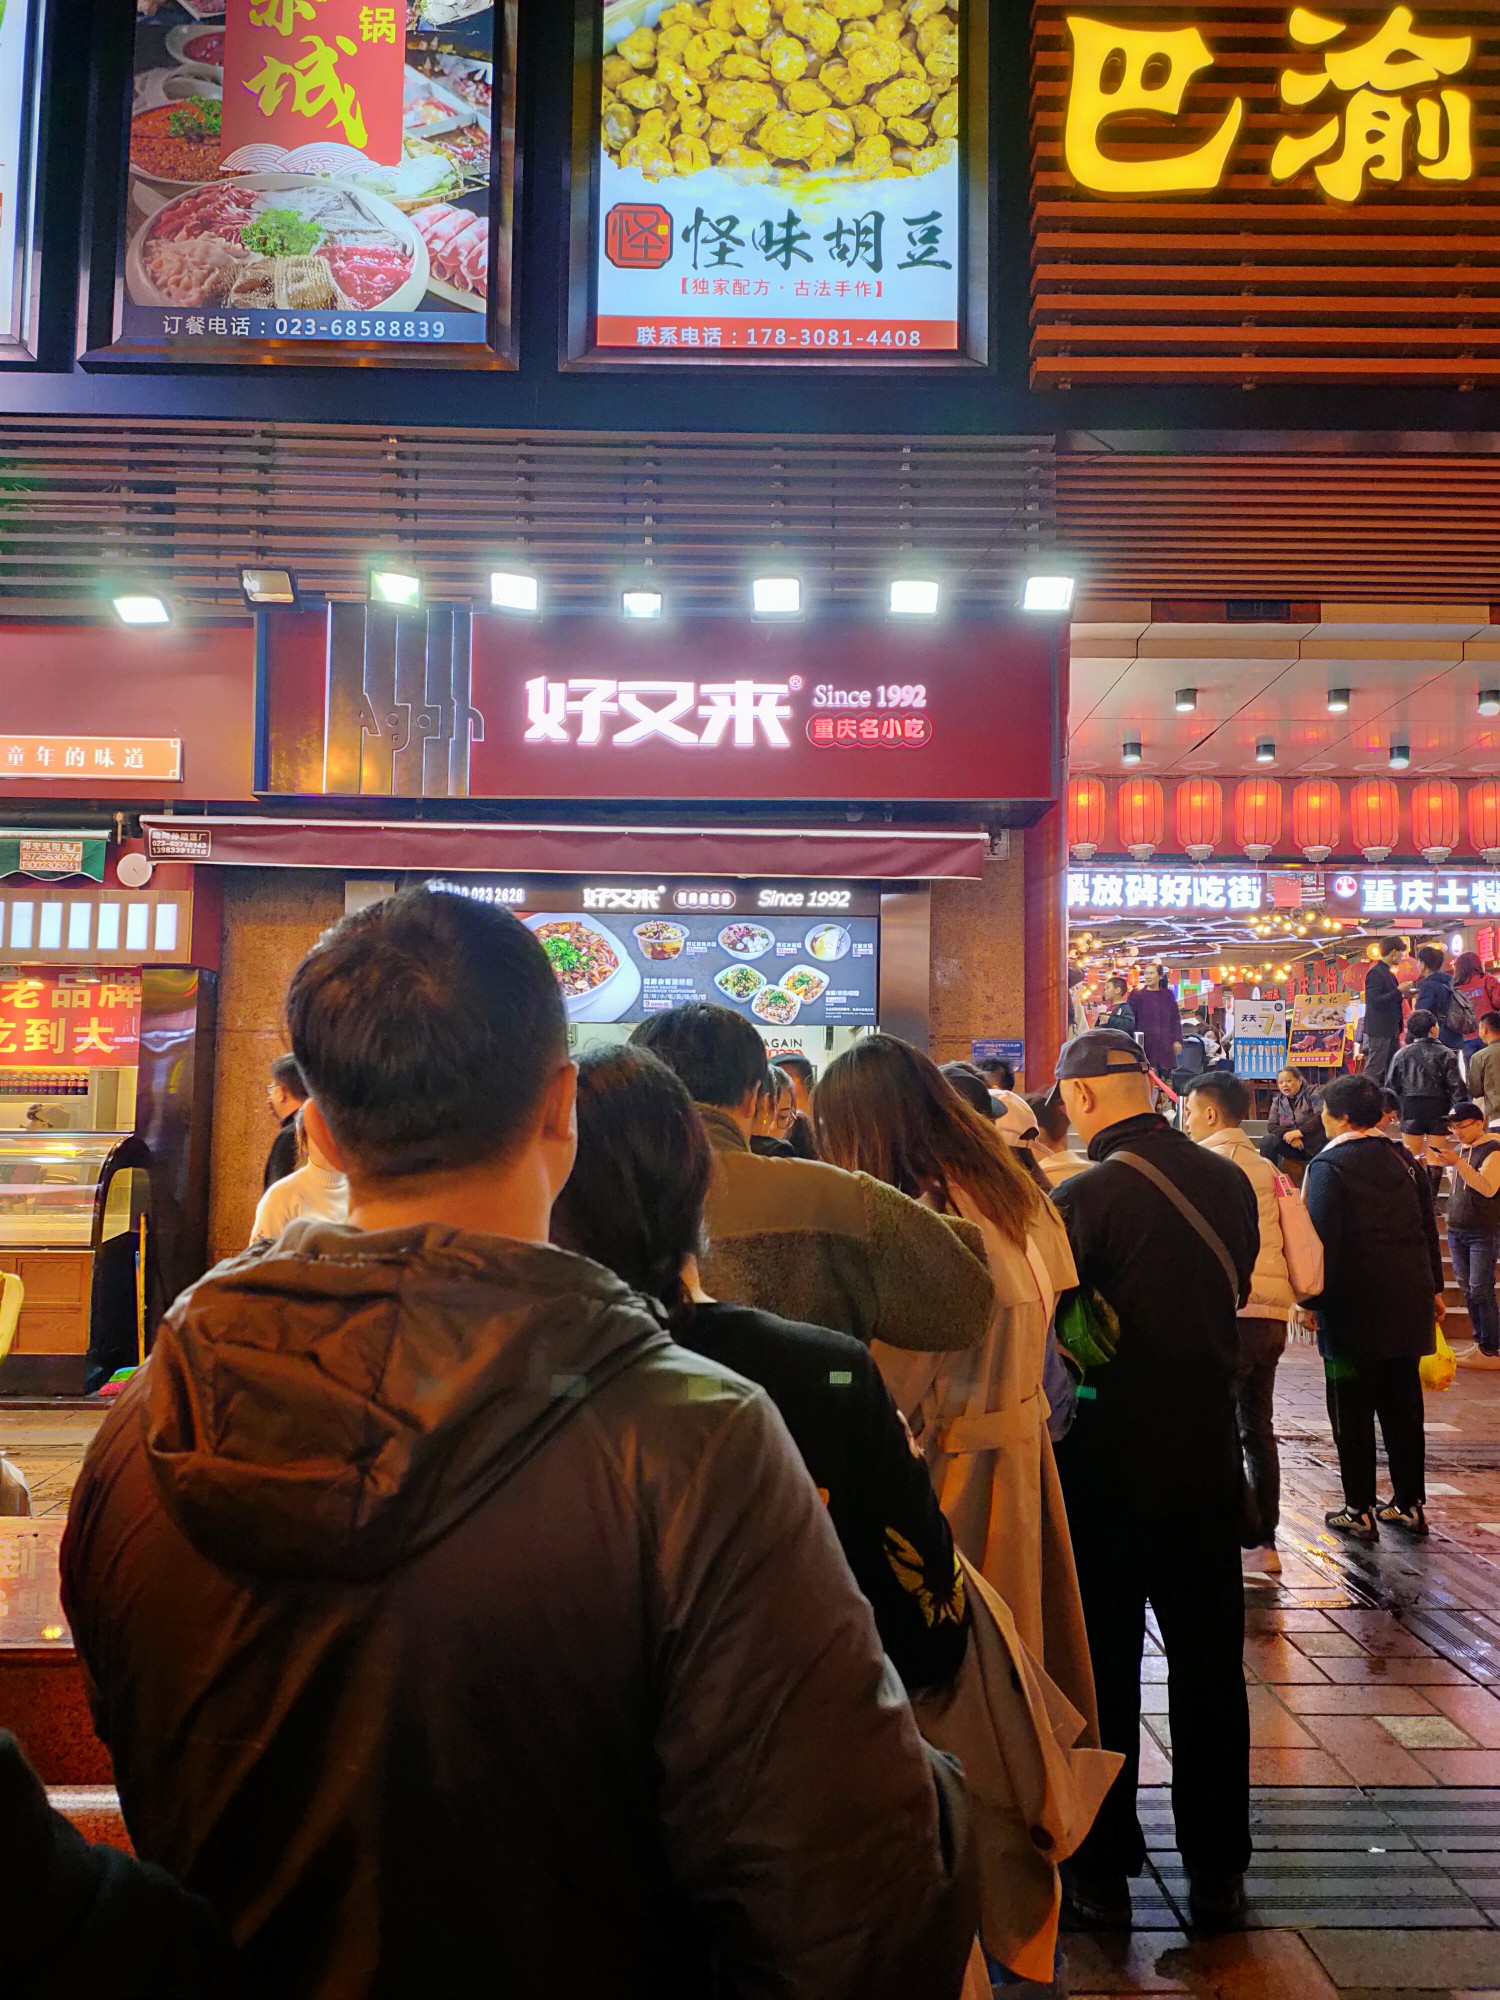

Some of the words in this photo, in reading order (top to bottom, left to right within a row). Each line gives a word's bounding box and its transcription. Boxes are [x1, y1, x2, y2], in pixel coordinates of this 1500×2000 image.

[1065, 6, 1472, 201] 巴渝
[681, 206, 953, 274] 怪味胡豆
[814, 684, 871, 708] Since
[876, 684, 928, 709] 1992
[813, 717, 925, 740] 重庆名小吃
[7, 745, 145, 769] 童年的味道
[494, 886, 526, 904] 2628
[757, 889, 804, 908] Since
[806, 890, 851, 908] 1992
[1066, 874, 1262, 908] 解放碑好吃街
